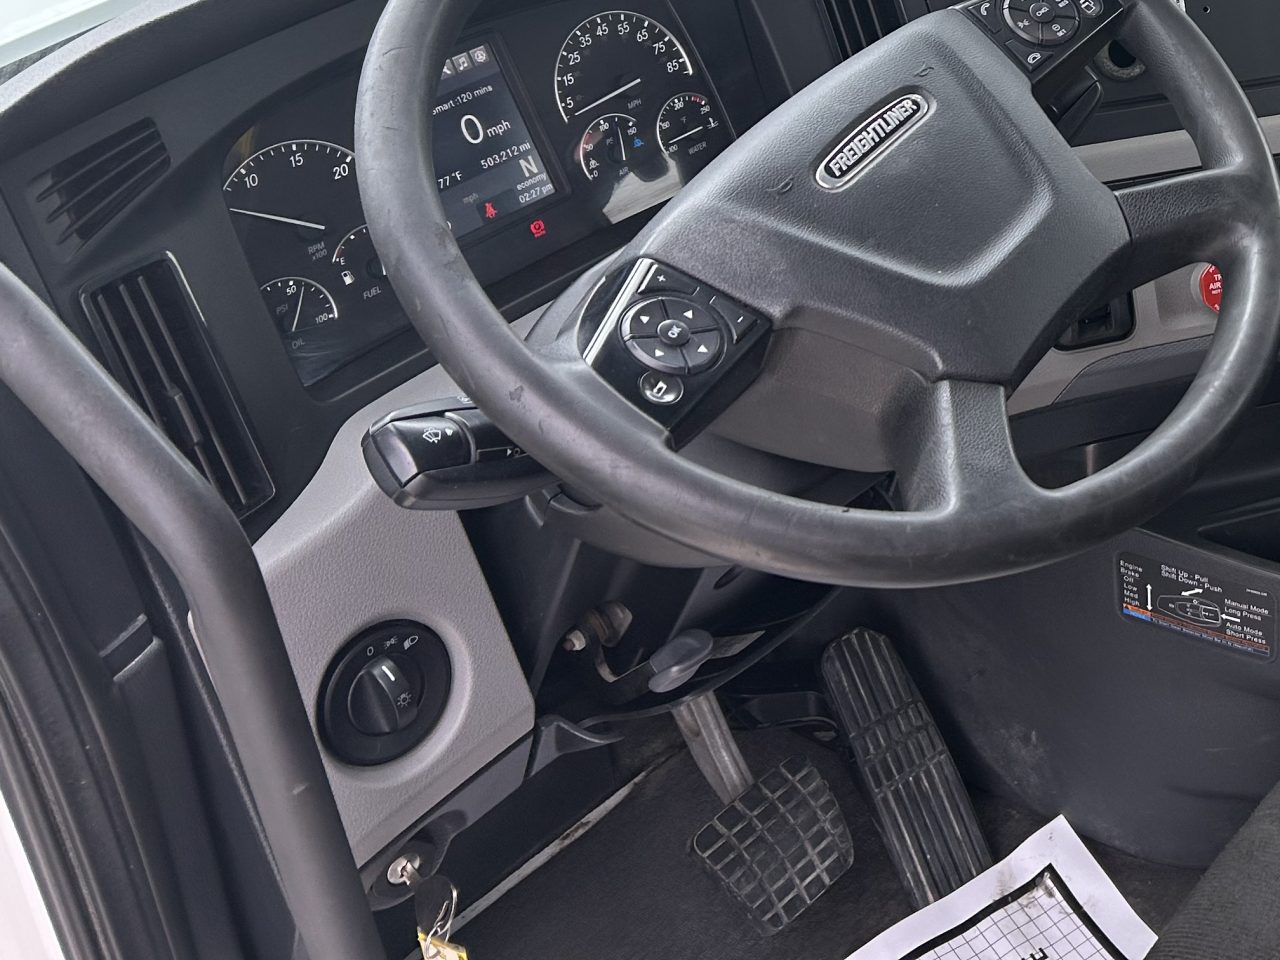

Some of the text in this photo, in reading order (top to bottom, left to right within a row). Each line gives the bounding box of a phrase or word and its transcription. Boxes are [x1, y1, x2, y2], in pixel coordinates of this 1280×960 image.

[596, 23, 609, 36] 45
[618, 22, 630, 35] 55
[636, 29, 649, 42] 65
[579, 35, 592, 48] 35
[653, 41, 666, 55] 75
[568, 52, 581, 66] 25
[667, 60, 679, 73] 85
[563, 73, 575, 87] 15
[474, 85, 493, 97] mins
[567, 97, 574, 108] 5
[627, 99, 642, 110] MPH
[674, 101, 684, 110] 200
[460, 114, 512, 144] 0 mph
[829, 99, 918, 177] FREIGHTLINER
[519, 142, 531, 152] mi
[688, 141, 707, 155] WATER
[289, 152, 304, 168] 15
[519, 155, 539, 177] N
[333, 164, 349, 180] 20
[244, 173, 259, 188] 10
[438, 176, 450, 189] 77
[517, 172, 547, 191] economy
[519, 183, 553, 203] 02:27 pm
[308, 241, 325, 255] RPM
[286, 285, 297, 296] 50
[363, 286, 382, 300] FUEL
[315, 313, 328, 324] 100
[667, 325, 682, 338] OK
[1120, 560, 1143, 572] Engine
[1120, 567, 1140, 578] Brake
[1161, 565, 1177, 575] Shift
[1178, 570, 1189, 578] Up
[1195, 574, 1209, 583] Pull
[1124, 583, 1138, 591] Low
[1161, 571, 1177, 580] Shift
[1178, 576, 1198, 586] Down
[1204, 583, 1223, 593] Push
[1124, 590, 1139, 599] Med
[1124, 597, 1140, 606] High
[1224, 598, 1269, 615] Manual Mode
[1224, 607, 1262, 621] Long Press
[1226, 622, 1263, 636] Auto Mode
[1226, 629, 1266, 645] Short Press
